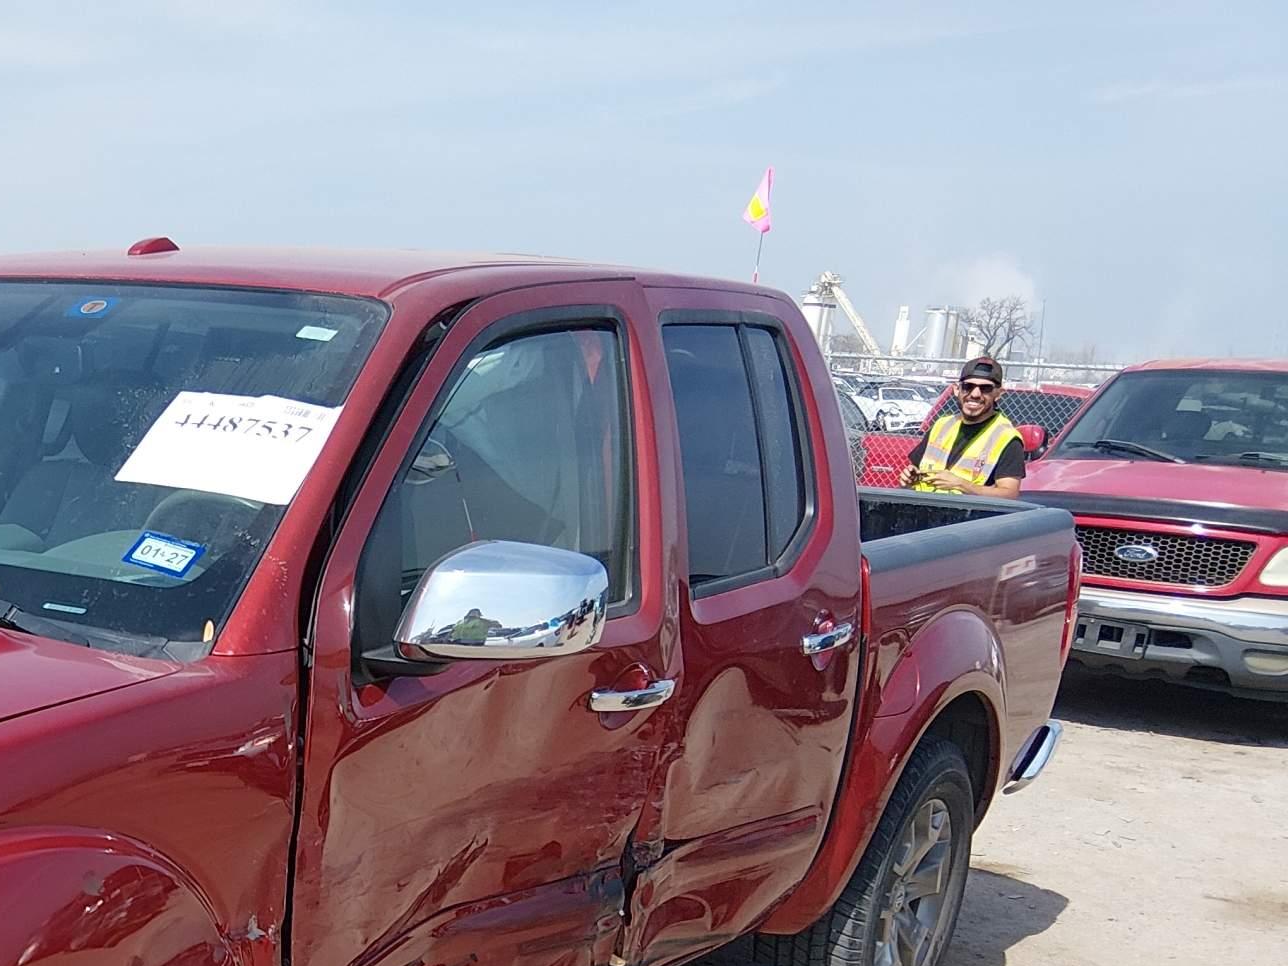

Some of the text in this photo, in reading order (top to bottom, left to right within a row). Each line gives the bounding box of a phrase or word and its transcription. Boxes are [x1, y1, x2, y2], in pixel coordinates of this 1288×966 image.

[175, 413, 313, 442] 44487537
[140, 545, 161, 559] 01
[164, 552, 189, 566] 27
